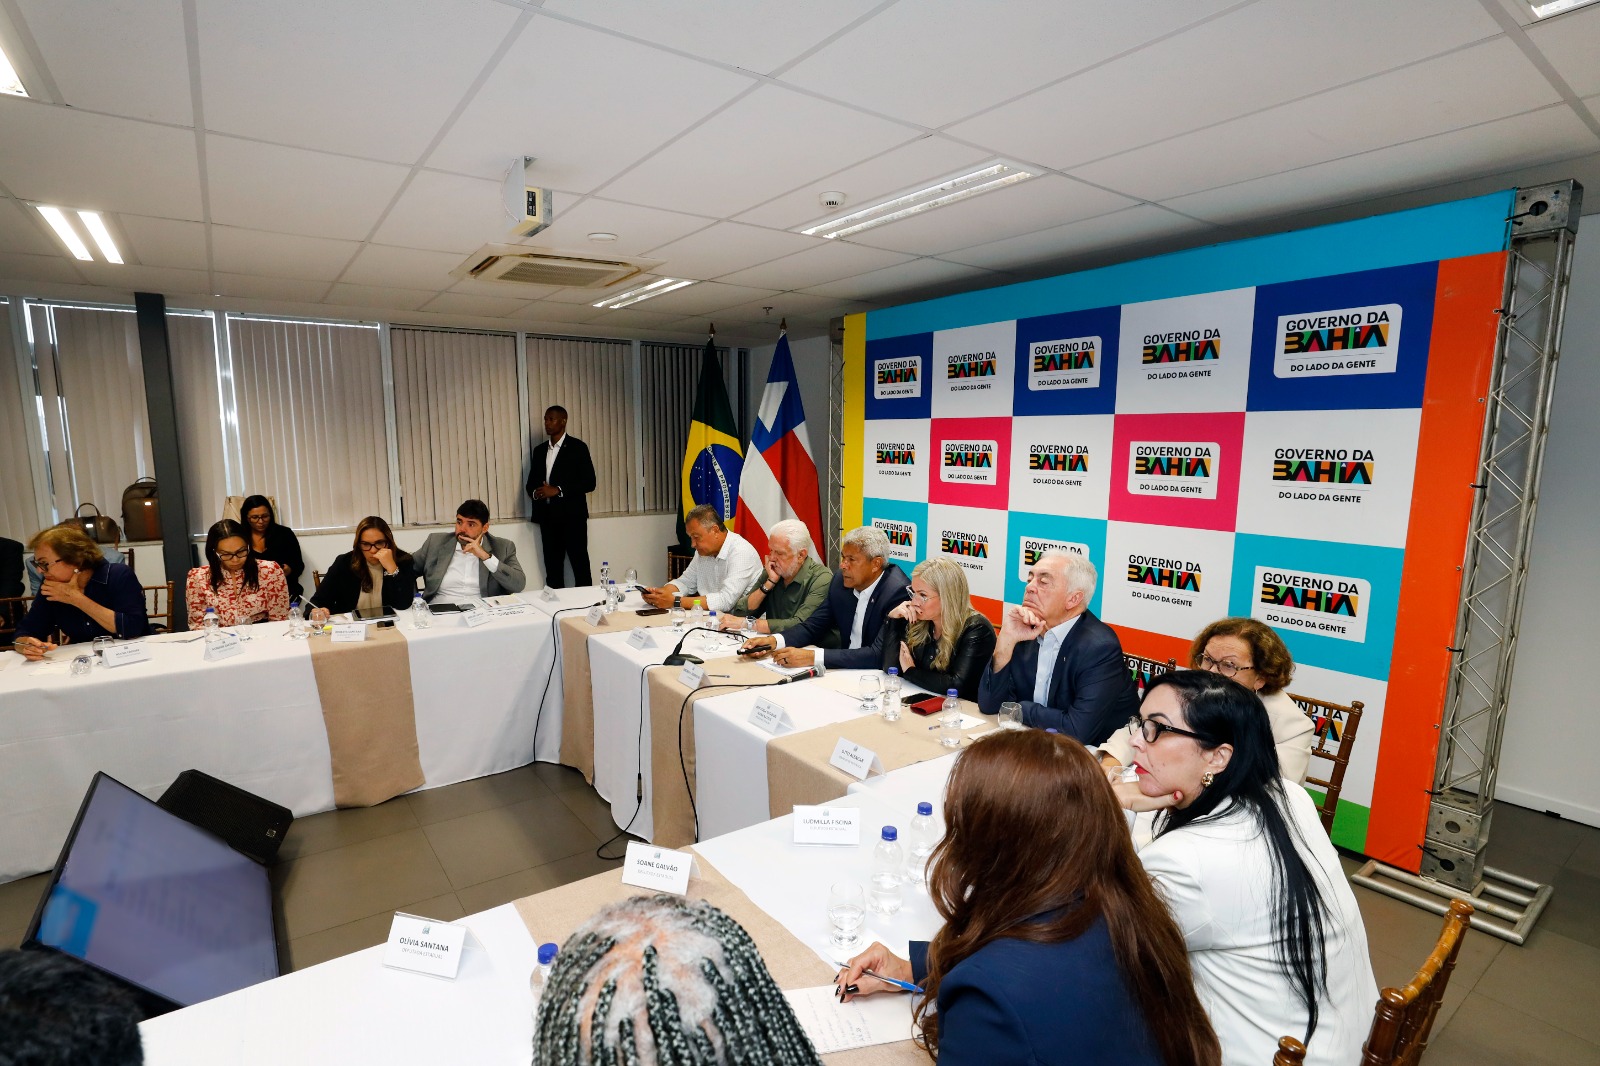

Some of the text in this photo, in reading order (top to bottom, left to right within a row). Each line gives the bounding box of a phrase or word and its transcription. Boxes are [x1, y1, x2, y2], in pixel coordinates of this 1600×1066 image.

[1286, 310, 1390, 331] GOVERNO DA
[1143, 328, 1221, 345] GOVERNO DA
[1034, 341, 1095, 355] GOVERNO DA
[947, 351, 996, 364] GOVERNO DA
[877, 359, 917, 371] GOVERNO DA
[1290, 359, 1376, 372] DO LADO DA GENTE
[1188, 370, 1211, 378] GENTE
[1046, 378, 1061, 386] LADO
[1070, 377, 1088, 385] GENTE
[876, 443, 915, 451] GOVERNO DA
[945, 443, 993, 452] GOVERNO DA
[1030, 444, 1089, 455] GOVERNO DA
[1136, 446, 1211, 457] GOVERNO DA
[1274, 448, 1374, 461] GOVERNO DA
[1151, 484, 1169, 492] LADO
[1170, 485, 1179, 493] DA
[1180, 486, 1202, 494] GENTE
[1278, 491, 1361, 503] DO LADO DA GENTE
[874, 521, 913, 533] GOVERNO DA
[941, 530, 989, 544] GOVERNO DA
[969, 563, 984, 571] GENTE
[1128, 554, 1202, 573] GOVERNO DA
[1263, 572, 1359, 595] GOVERNO DA
[1142, 592, 1160, 601] LADO
[1161, 595, 1170, 603] DA
[1171, 597, 1192, 607] GENTE
[1266, 614, 1347, 634] DO LADO DA GENTE
[399, 937, 449, 952] OLÍVIA SANTANA
